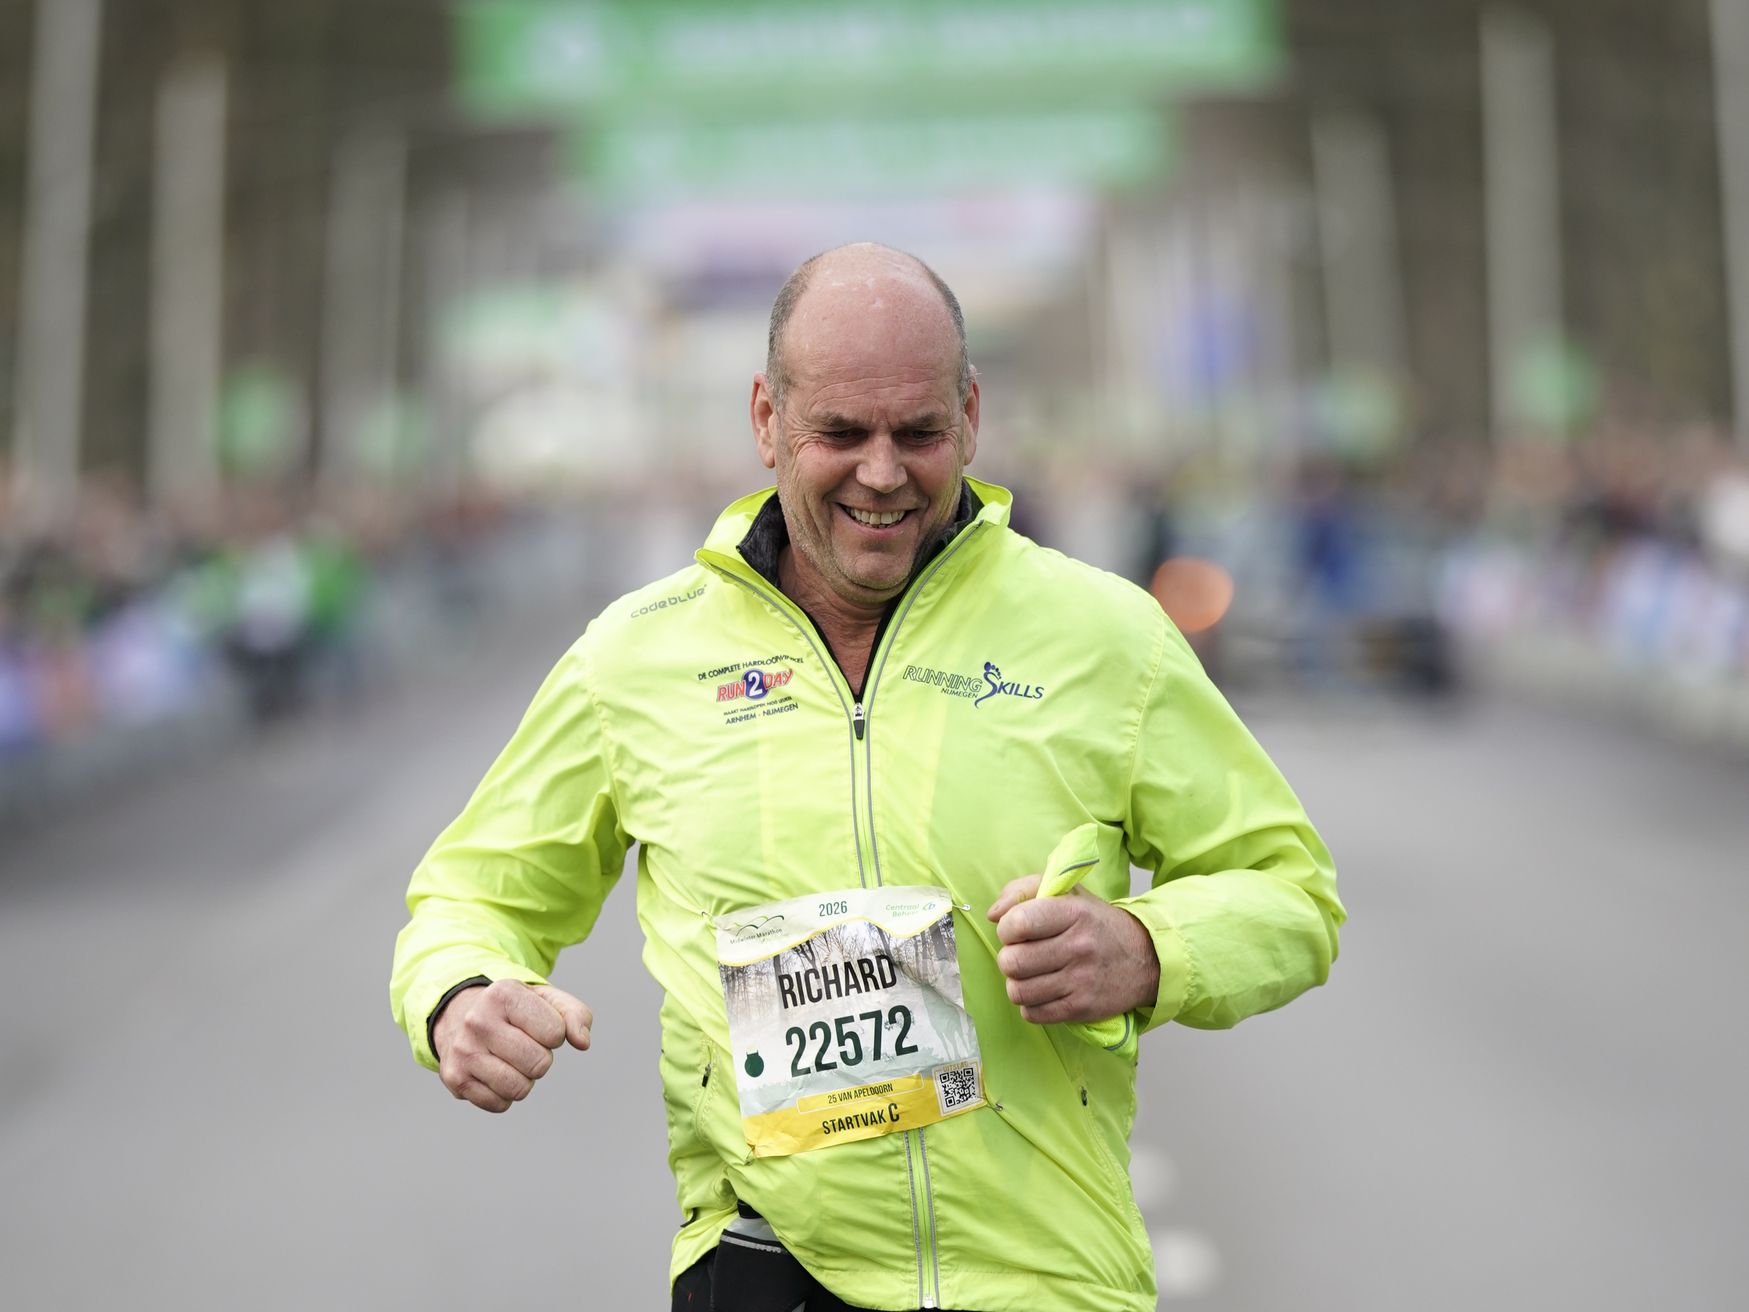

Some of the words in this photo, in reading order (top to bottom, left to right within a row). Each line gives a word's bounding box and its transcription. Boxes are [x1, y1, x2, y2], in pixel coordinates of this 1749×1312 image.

[698, 671, 707, 681] DE
[708, 663, 741, 678] COMPLETE
[902, 664, 984, 693] RUNNING
[974, 664, 1045, 709] SKILLS
[725, 712, 757, 725] ARNHEM
[762, 702, 799, 717] NIJMEGEN
[818, 900, 848, 918] 2026
[778, 954, 898, 1010] RICHARD
[785, 1004, 919, 1078] 22572
[827, 1094, 838, 1104] 25
[838, 1091, 853, 1102] VAN
[853, 1082, 893, 1099] APELDOORN
[821, 1107, 886, 1135] STARTVAK
[887, 1102, 900, 1123] C
